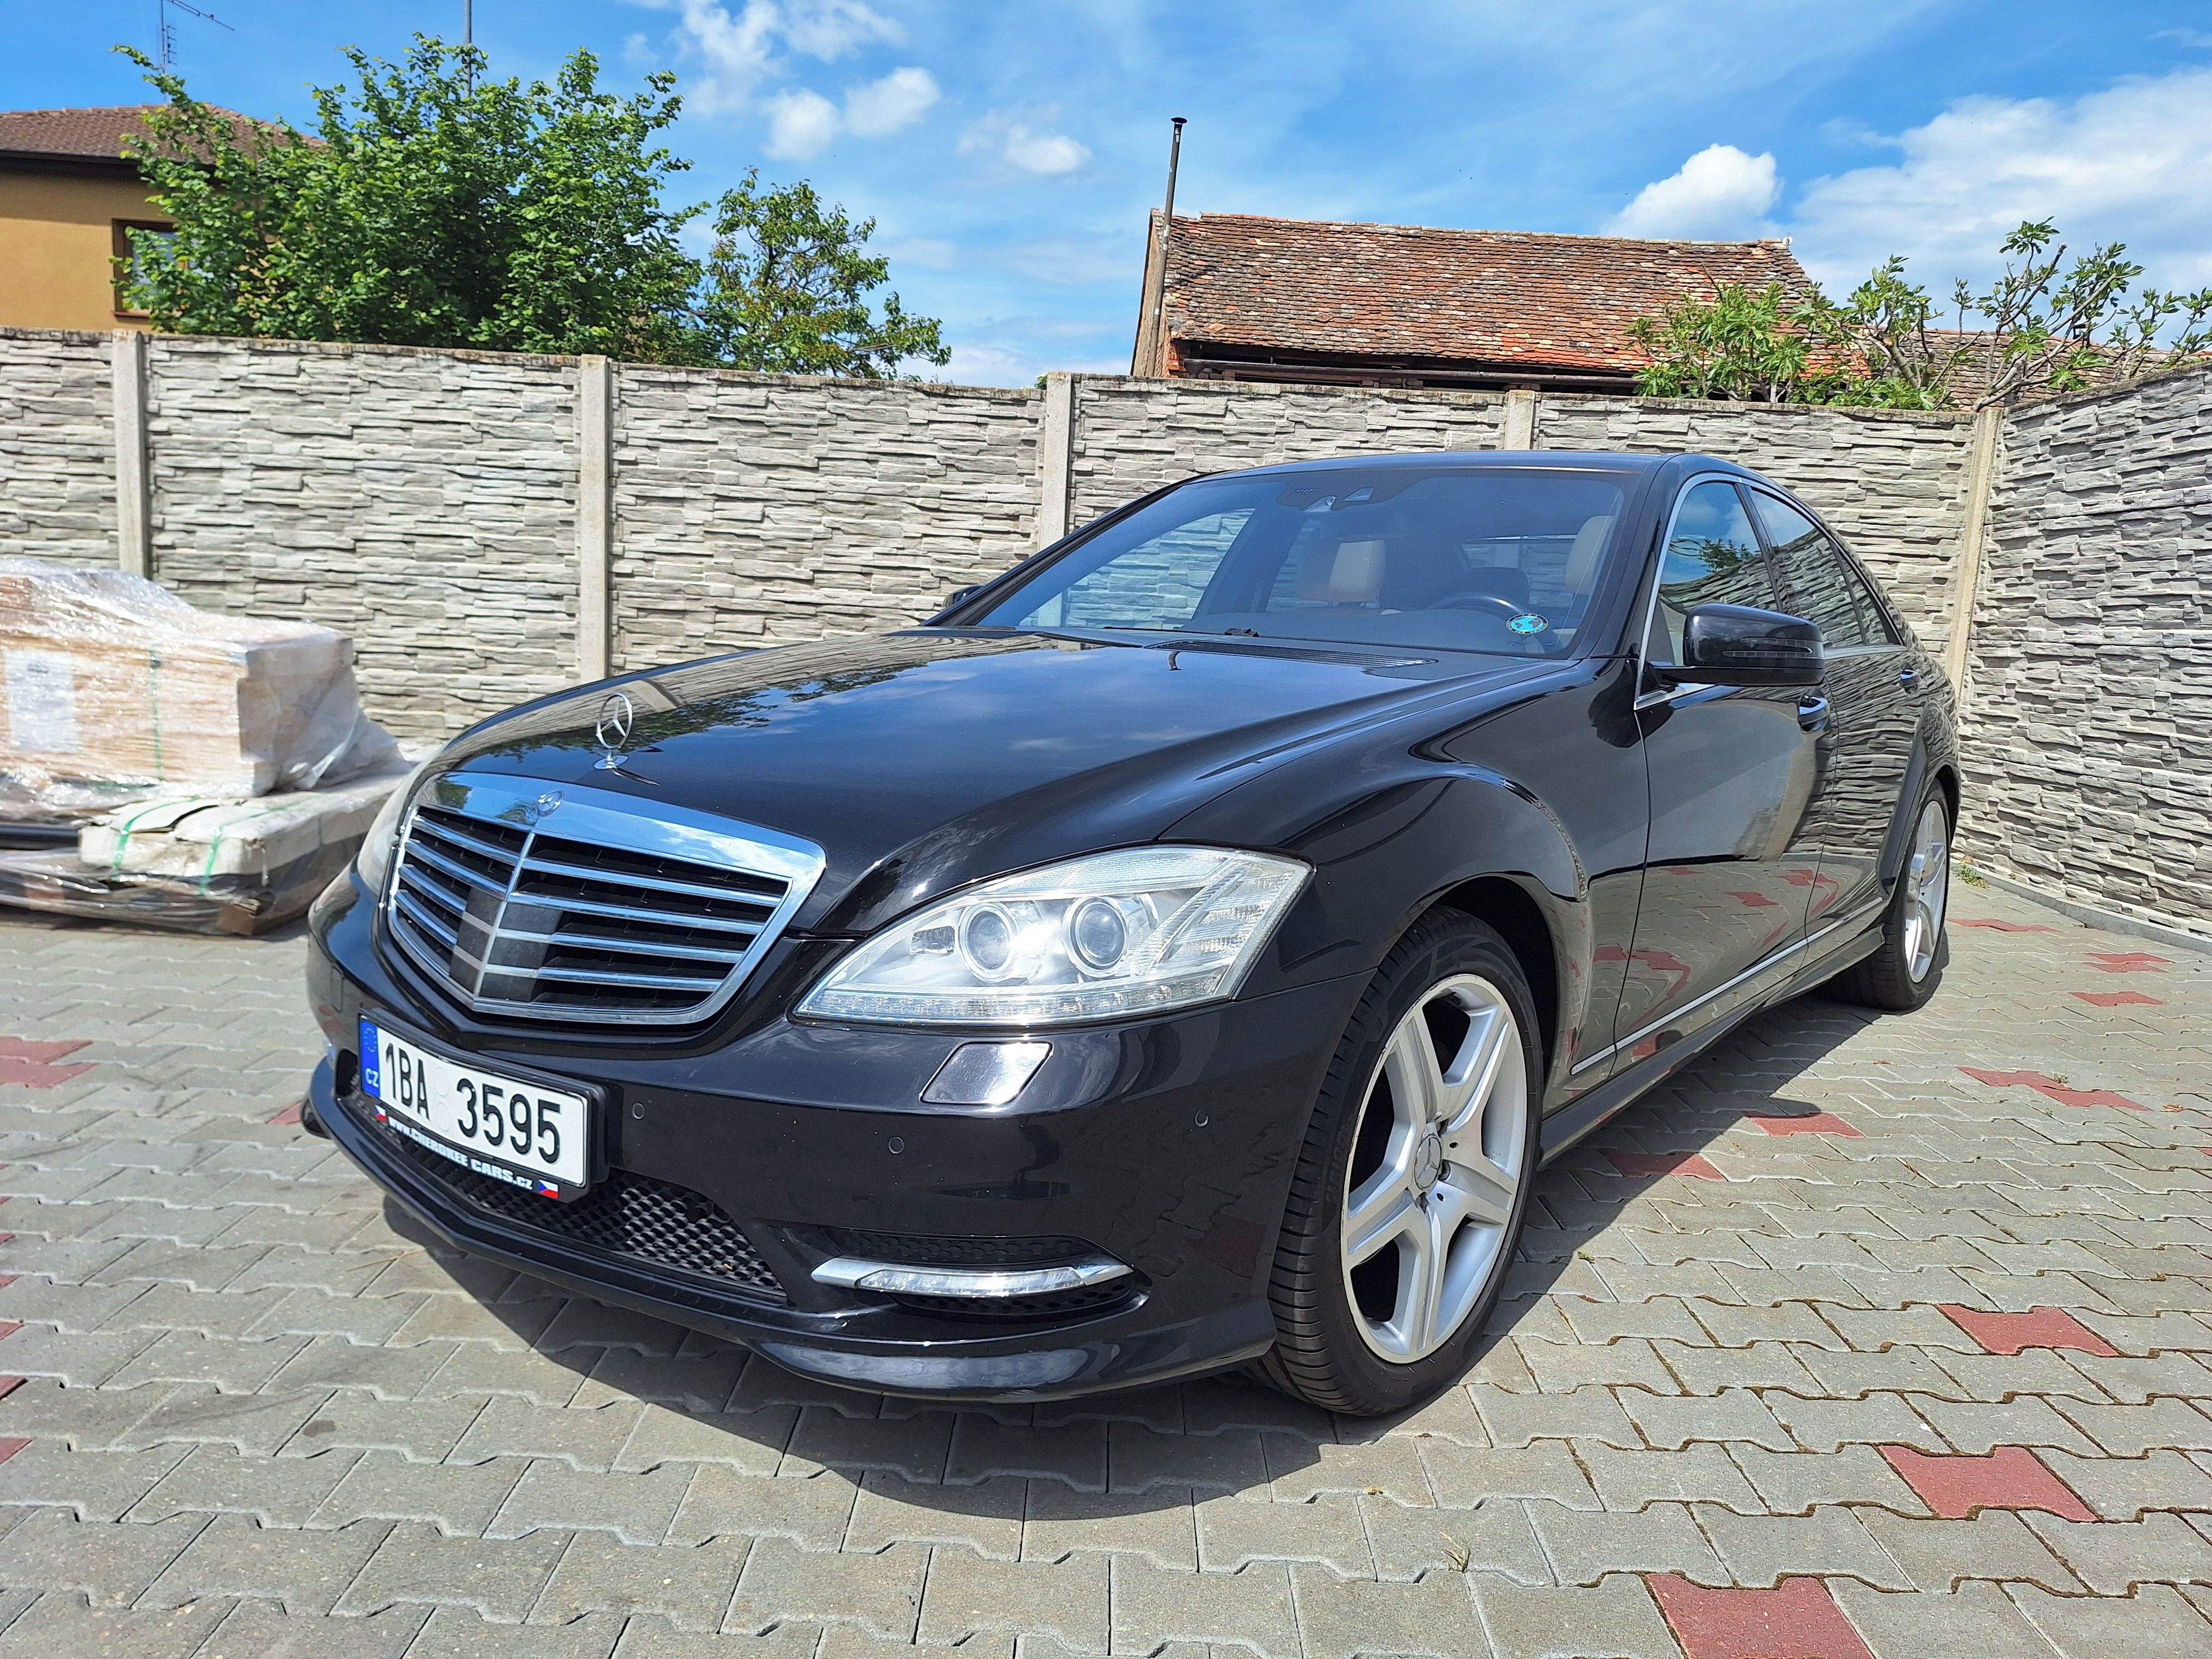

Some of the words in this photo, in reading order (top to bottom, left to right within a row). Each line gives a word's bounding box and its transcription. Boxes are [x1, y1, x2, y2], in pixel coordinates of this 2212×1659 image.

[365, 1068, 379, 1088] CZ
[386, 1043, 430, 1121] 1BA
[456, 1078, 561, 1164] 3595
